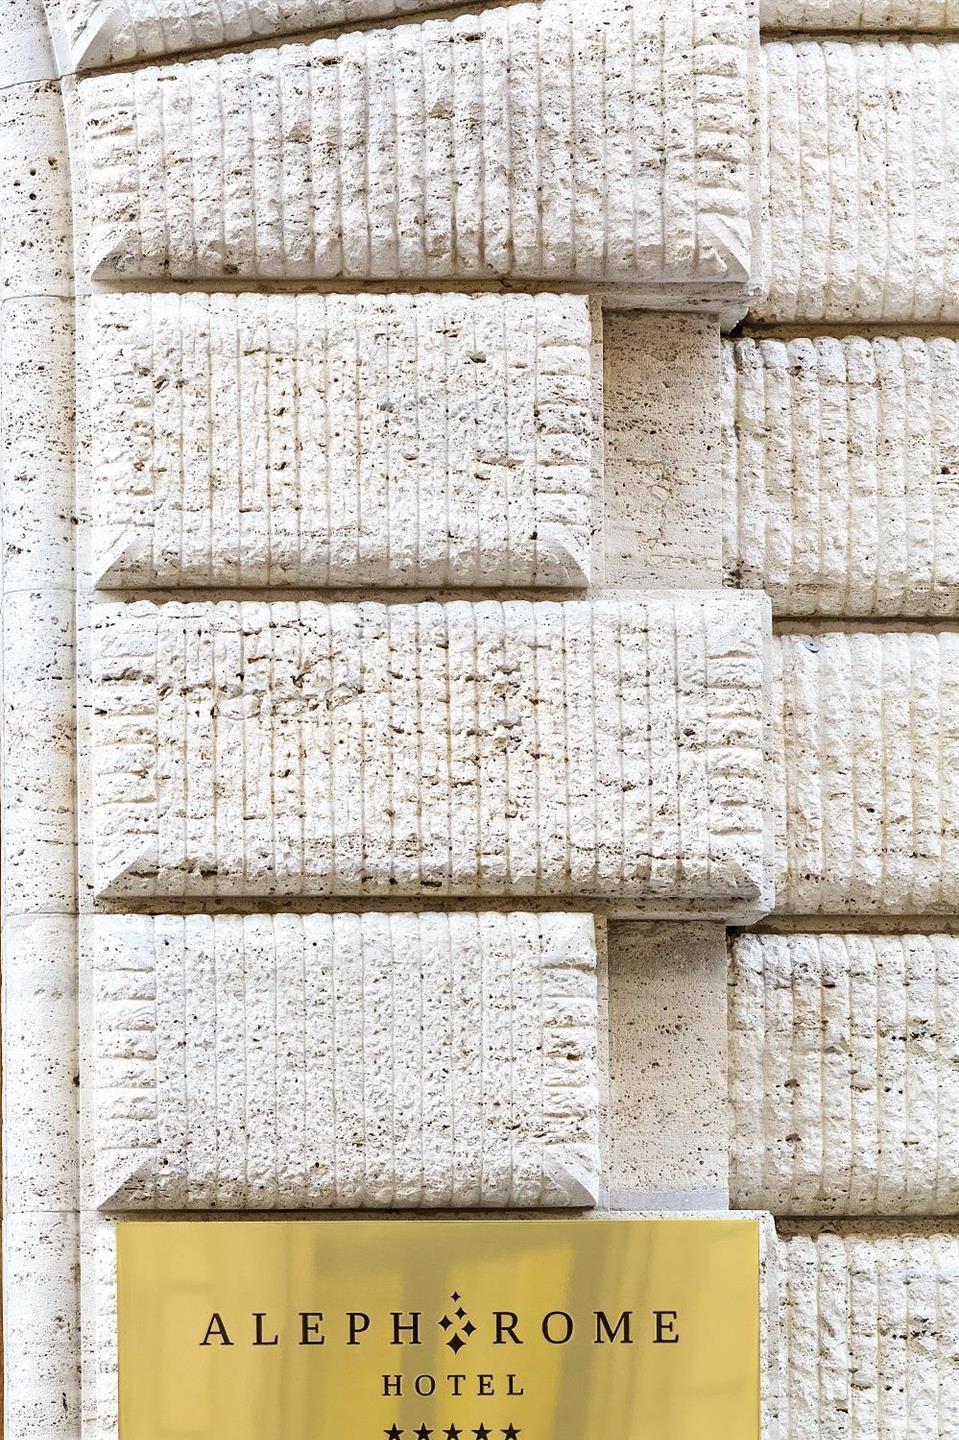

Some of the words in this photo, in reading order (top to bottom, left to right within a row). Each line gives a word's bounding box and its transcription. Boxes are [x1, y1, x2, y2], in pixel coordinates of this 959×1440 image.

[199, 1311, 423, 1346] ALEPH
[492, 1310, 680, 1345] ROME
[382, 1374, 525, 1397] HOTEL
